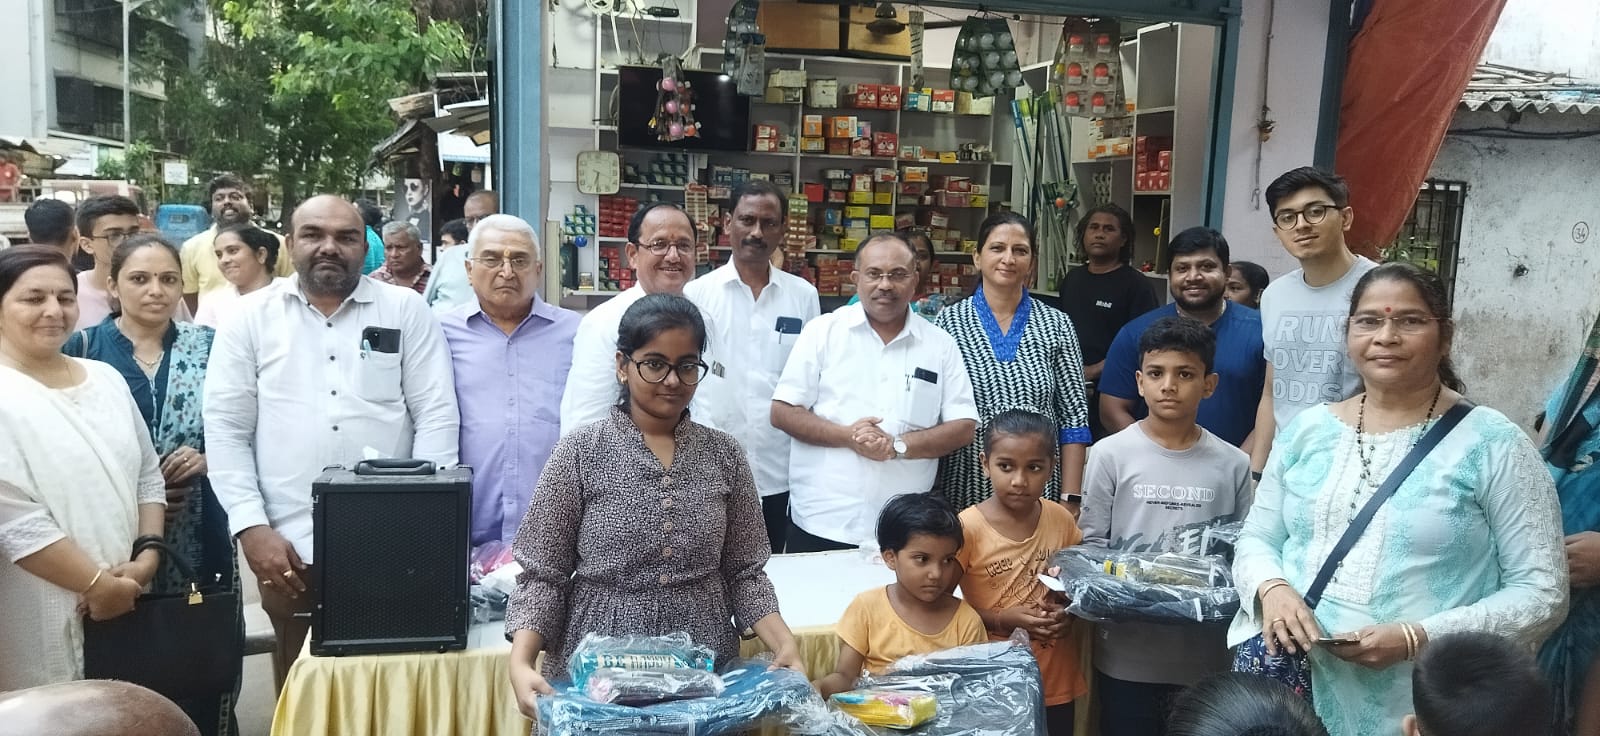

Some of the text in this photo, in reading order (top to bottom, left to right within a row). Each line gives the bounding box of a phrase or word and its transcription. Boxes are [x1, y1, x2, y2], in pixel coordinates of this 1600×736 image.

[1575, 227, 1586, 240] 34
[1275, 315, 1346, 344] RUN
[1273, 347, 1344, 375] OVER
[1272, 378, 1344, 404] ODDS
[1132, 484, 1216, 502] SECOND
